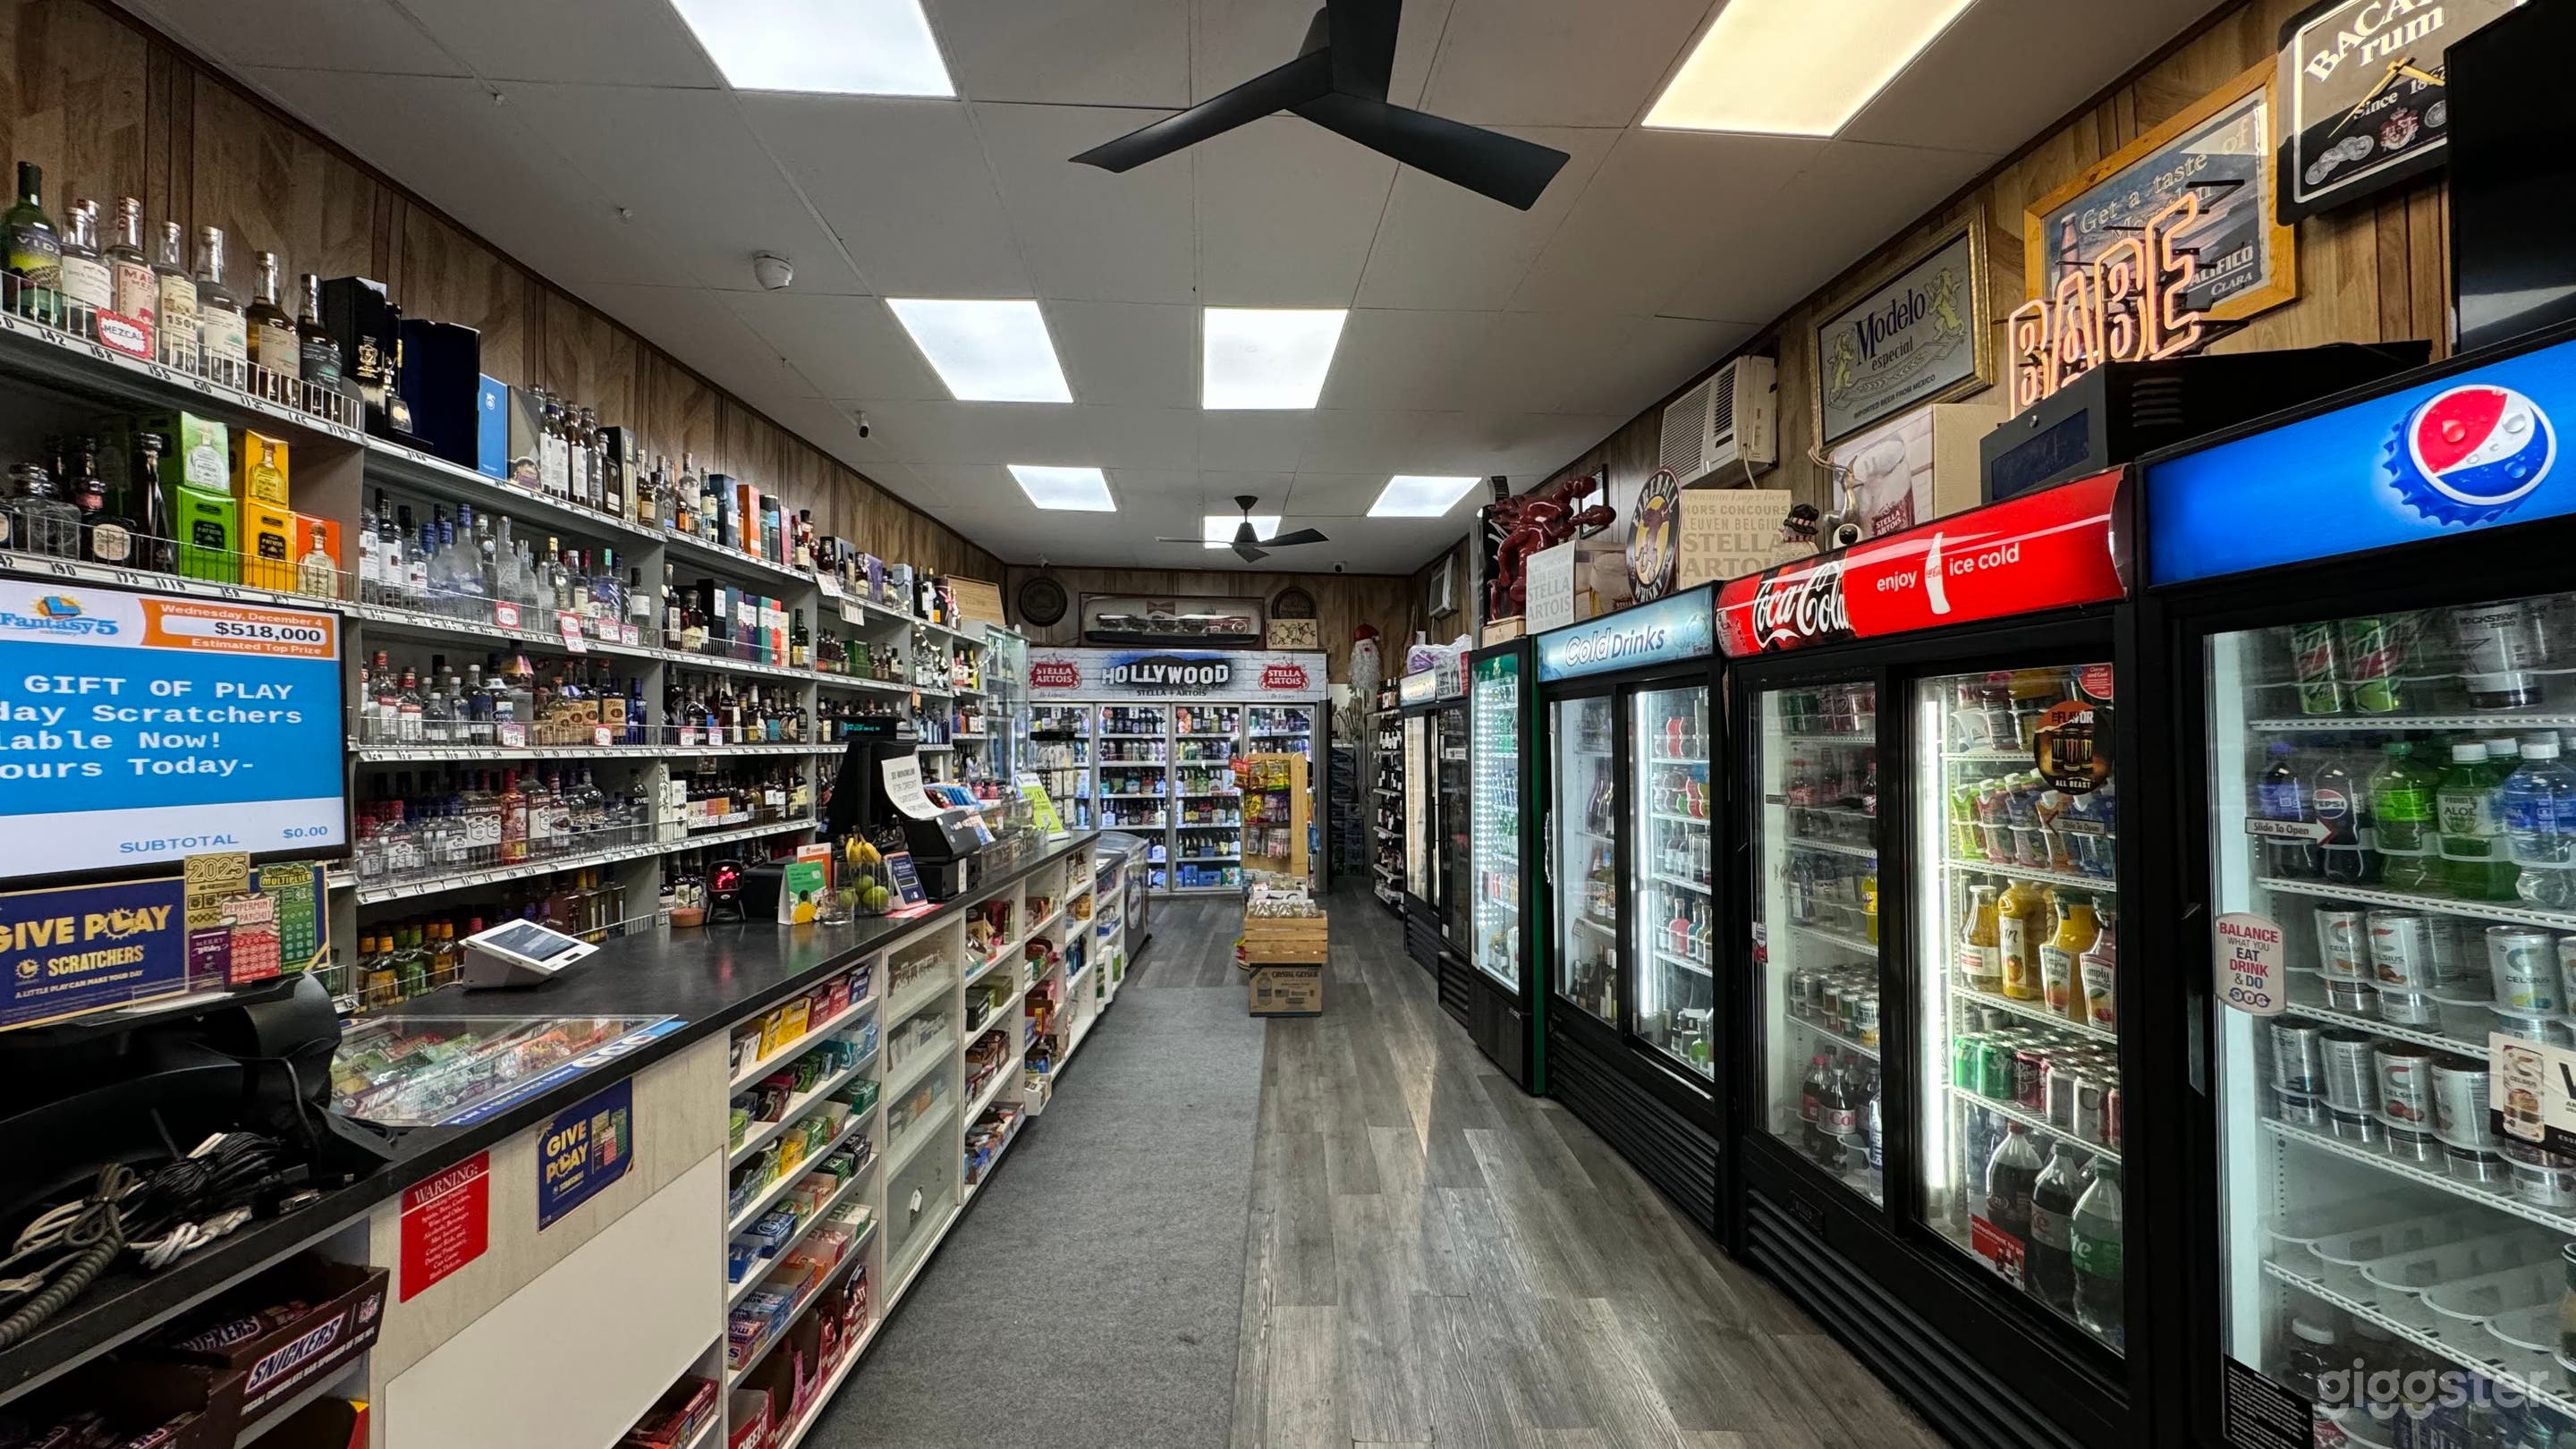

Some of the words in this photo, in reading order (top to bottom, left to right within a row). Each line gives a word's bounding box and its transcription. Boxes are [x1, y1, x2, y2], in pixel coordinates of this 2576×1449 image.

[2304, 0, 2433, 83] BACA
[2360, 6, 2445, 67] rum
[2353, 91, 2399, 120] Since
[2080, 200, 2118, 234] Get
[2128, 188, 2140, 208] a
[2152, 152, 2209, 194] taste
[2221, 115, 2249, 155] of
[2176, 244, 2254, 288] ACIFICO
[2210, 271, 2254, 296] CLARA
[103, 324, 144, 341] MEZCAL
[1856, 288, 1927, 366] Modelo
[1870, 336, 1914, 372] especial
[1853, 402, 1879, 419] IMPORTED
[1880, 394, 1896, 407] BEER
[1896, 385, 1912, 400] FROM
[1912, 374, 1936, 394] MEXICO
[1631, 473, 1679, 528] FIREBALL
[1682, 504, 1716, 516] HORS
[1719, 504, 1788, 516] CONCOURS
[1682, 518, 1730, 531] LEUVEN
[1734, 518, 1783, 531] BELGIU
[1876, 509, 1901, 529] STELLA
[1877, 516, 1902, 538] ARTOIS
[1682, 532, 1783, 553] STELLA
[1682, 557, 1775, 578] ARTOI
[1877, 567, 1919, 594] enjoy
[1949, 555, 1975, 577] ice
[1977, 541, 2021, 571] cold
[1527, 576, 1572, 603] STELLA
[160, 602, 245, 623] Wednesday,
[248, 610, 310, 625] December
[315, 617, 323, 626] 4
[1526, 595, 1572, 622] ARTOIS
[0, 612, 97, 635] Fantasy
[215, 621, 322, 644] $518,000
[191, 638, 261, 653] Estimated
[264, 642, 289, 656] Top
[292, 644, 322, 655] Prize
[1565, 626, 1612, 667] Cold
[1611, 625, 1665, 659] Drinks
[1036, 666, 1073, 676] STELLA
[1036, 674, 1073, 684] ARTOIS
[1101, 664, 1229, 685] HOLLYWOOD
[1267, 670, 1301, 678] STELLA
[1267, 678, 1301, 686] ARTOIS
[24, 674, 126, 697] GIFT
[150, 679, 192, 699] OF
[216, 682, 293, 701] PLAY
[1137, 690, 1166, 698] STELLA
[92, 704, 302, 725] Scratchers
[139, 731, 221, 750] Now!
[128, 757, 254, 781] Today-
[2055, 779, 2068, 788] ALL
[2069, 780, 2092, 790] BEAST
[2444, 806, 2477, 817] ALOE
[2062, 820, 2074, 829] Slide
[2075, 821, 2082, 831] To
[2082, 823, 2100, 833] Open
[2253, 821, 2273, 834] Slide
[2275, 823, 2284, 835] To
[2286, 824, 2309, 837] Open
[120, 834, 239, 854] SUBTOTAL
[283, 826, 328, 839] $0.00
[185, 855, 249, 884] 2025
[260, 872, 313, 886] MULTIPLIER
[224, 898, 274, 915] PEPPERMINT
[238, 910, 272, 923] PAYOUT
[0, 916, 74, 953] GIVE
[85, 904, 173, 941] PLAY
[2218, 921, 2279, 944] BALANCE
[2227, 936, 2250, 947] WHAT
[2251, 940, 2270, 952] YOU
[47, 944, 145, 978] SCRATCHERS
[2229, 959, 2269, 978] DRINK
[14, 991, 22, 1000] A
[22, 986, 49, 998] LITTLE
[50, 983, 68, 994] PLAY
[68, 979, 86, 989] CAN
[87, 976, 108, 986] MAKE
[109, 972, 129, 982] YOUR
[129, 970, 144, 979] DAY
[2234, 973, 2244, 985] &
[2245, 975, 2264, 989] DO
[2505, 974, 2551, 985] CELSIUS
[2509, 1074, 2538, 1089] CELSIUS
[2383, 1089, 2422, 1100] CELSIUS
[547, 1119, 587, 1157] GIVE
[546, 1141, 589, 1185] PLAY
[414, 1164, 479, 1205] WARNING:
[250, 1318, 341, 1389] SNICKERS
